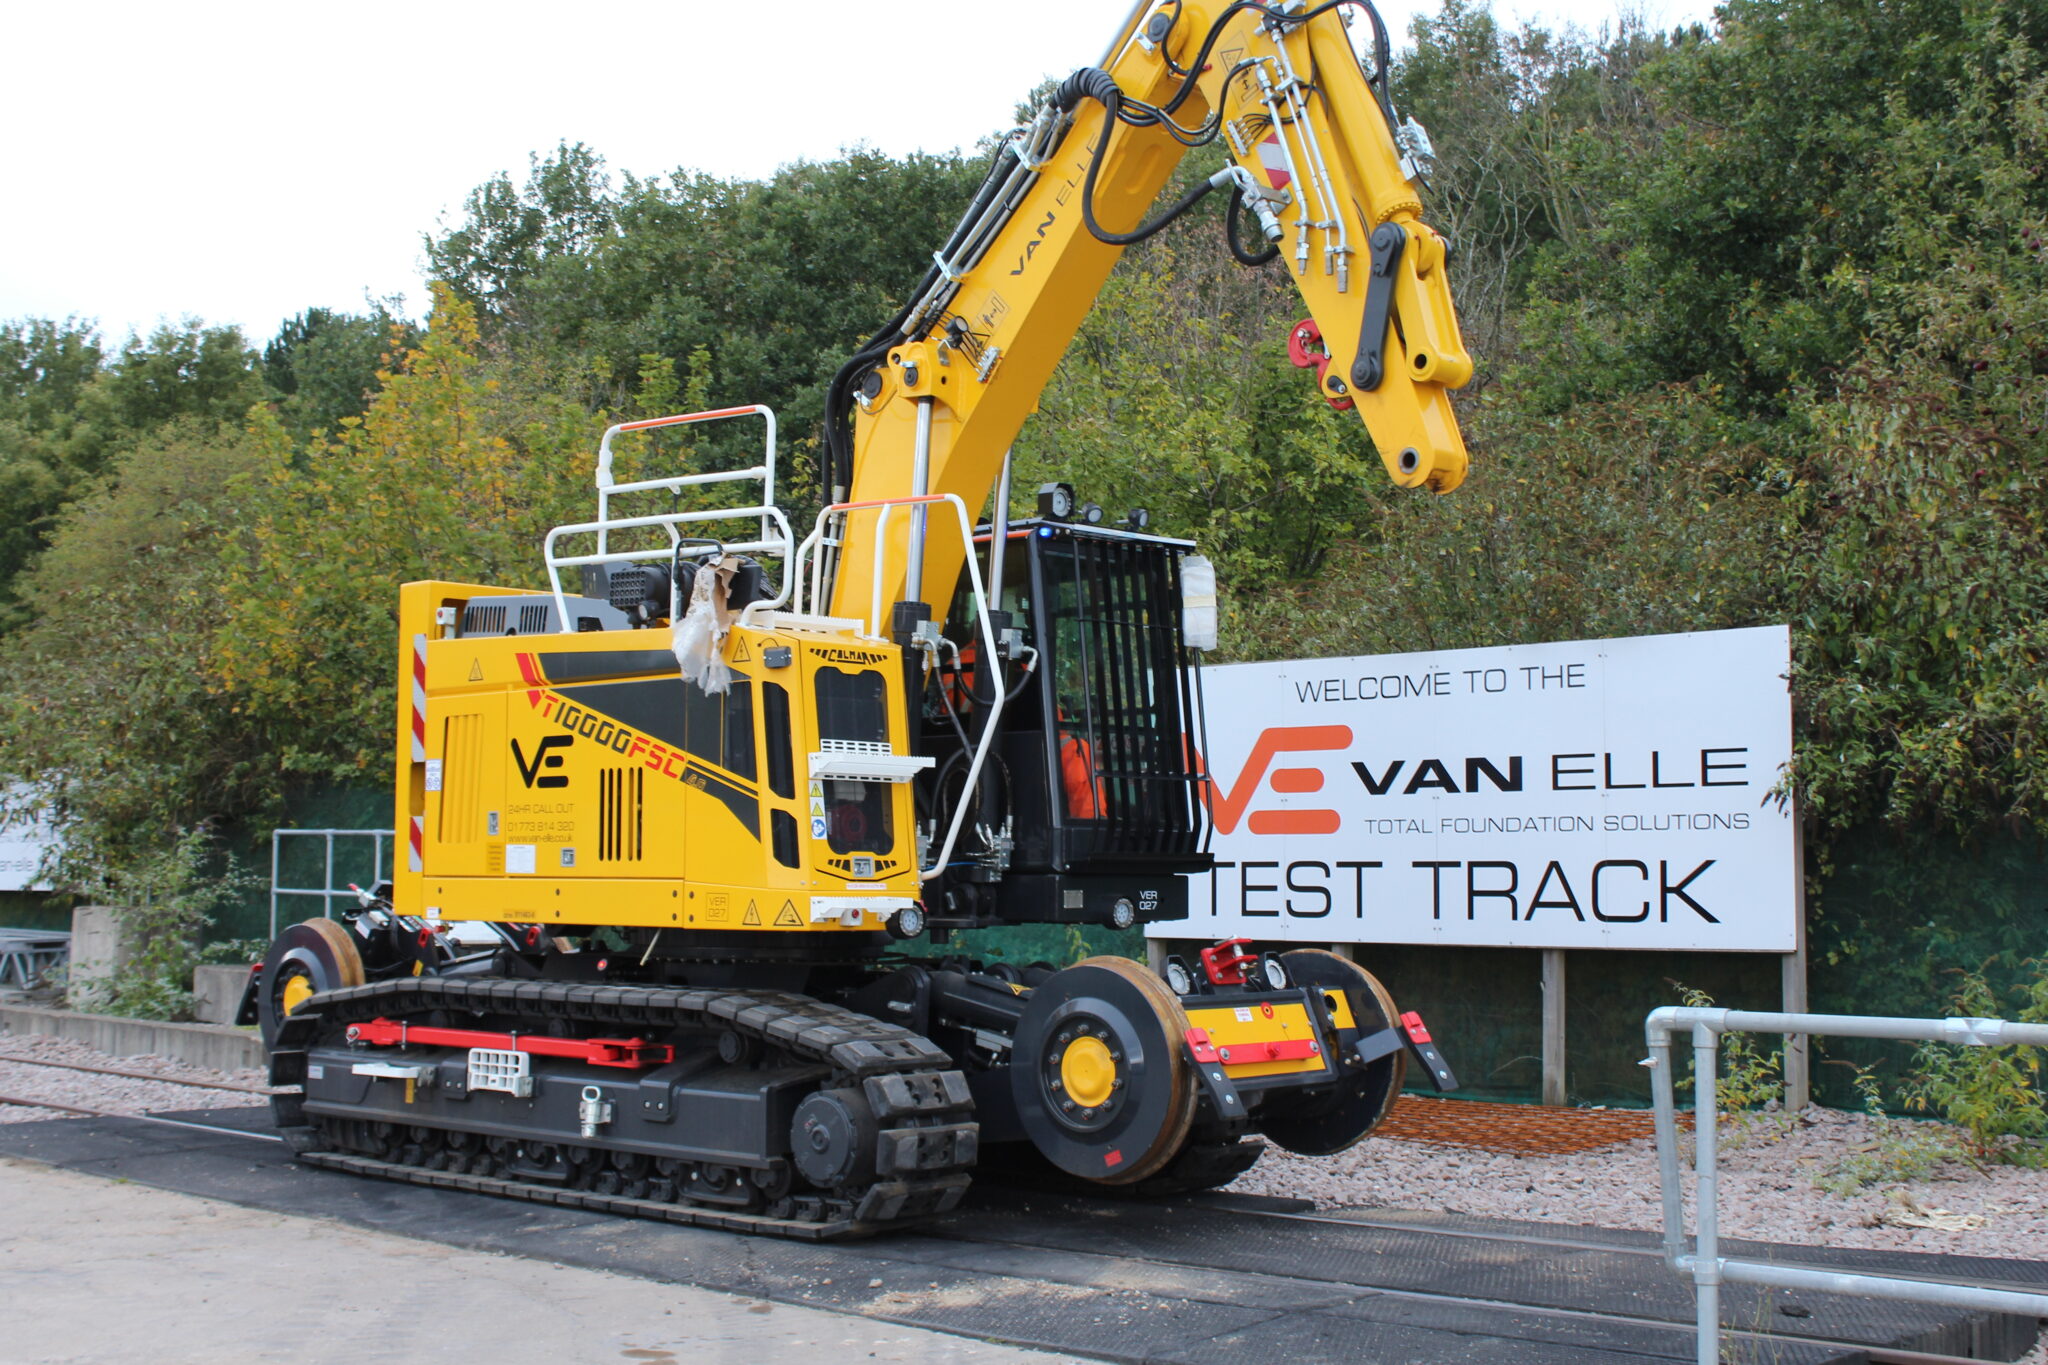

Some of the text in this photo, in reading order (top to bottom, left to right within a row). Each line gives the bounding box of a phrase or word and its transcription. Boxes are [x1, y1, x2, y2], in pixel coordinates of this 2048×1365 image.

[1010, 132, 1099, 276] VAN ELLE
[828, 649, 872, 665] COLMAR
[1295, 664, 1586, 703] WELCOME TO THE
[542, 694, 685, 779] T10000FSC
[511, 735, 574, 789] VE
[1351, 747, 1749, 796] VAN ELLE
[508, 803, 575, 815] 24HR CALL OUT
[508, 821, 536, 832] 01773
[557, 820, 575, 831] 320
[1365, 812, 1750, 835] TOTAL FOUNDATION SOLUTIONS
[709, 896, 726, 906] VER
[1140, 890, 1158, 900] VER
[1211, 859, 1722, 924] TEST TRACK
[1139, 901, 1158, 910] 027
